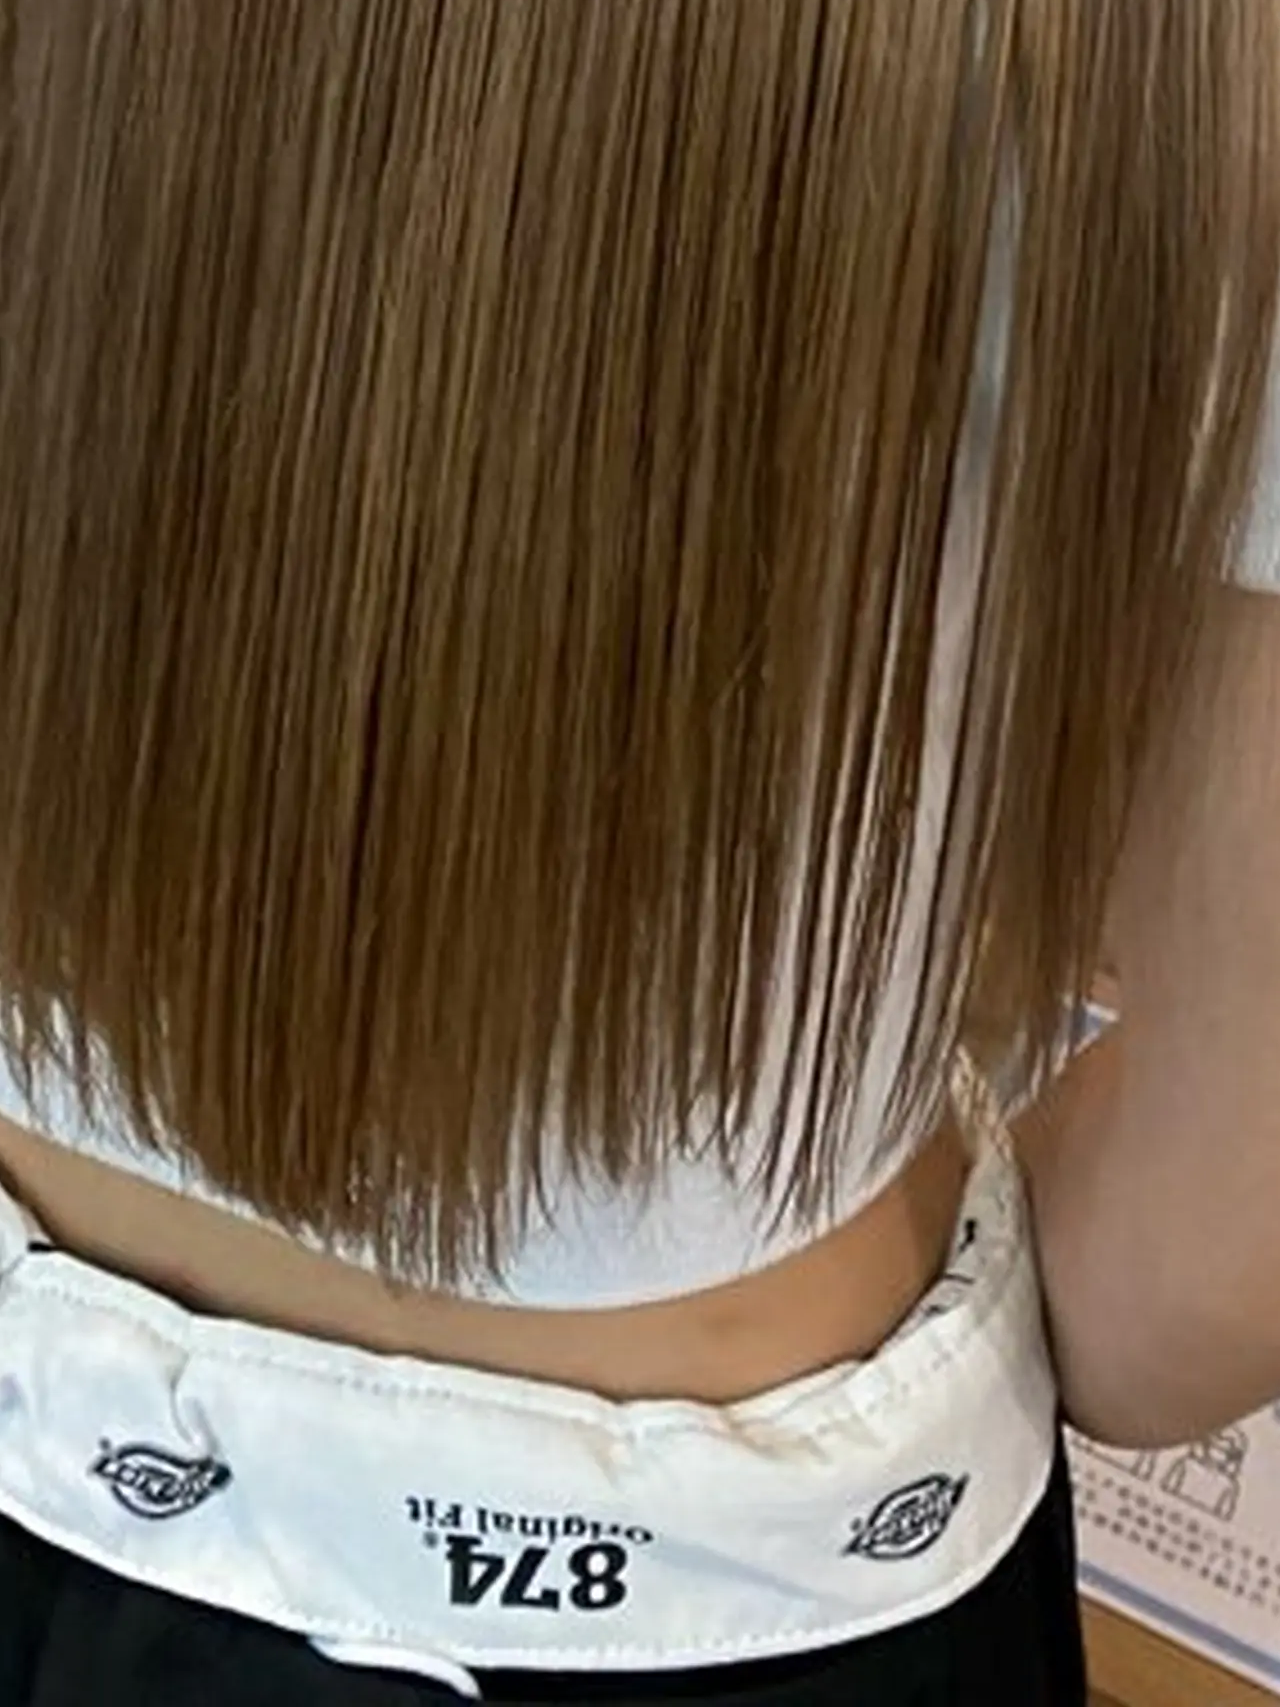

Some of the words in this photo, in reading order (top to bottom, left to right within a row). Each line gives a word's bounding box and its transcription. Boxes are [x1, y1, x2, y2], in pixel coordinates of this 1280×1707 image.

[405, 1495, 463, 1529] Fit
[477, 1507, 654, 1545] Original
[446, 1533, 628, 1611] 874
